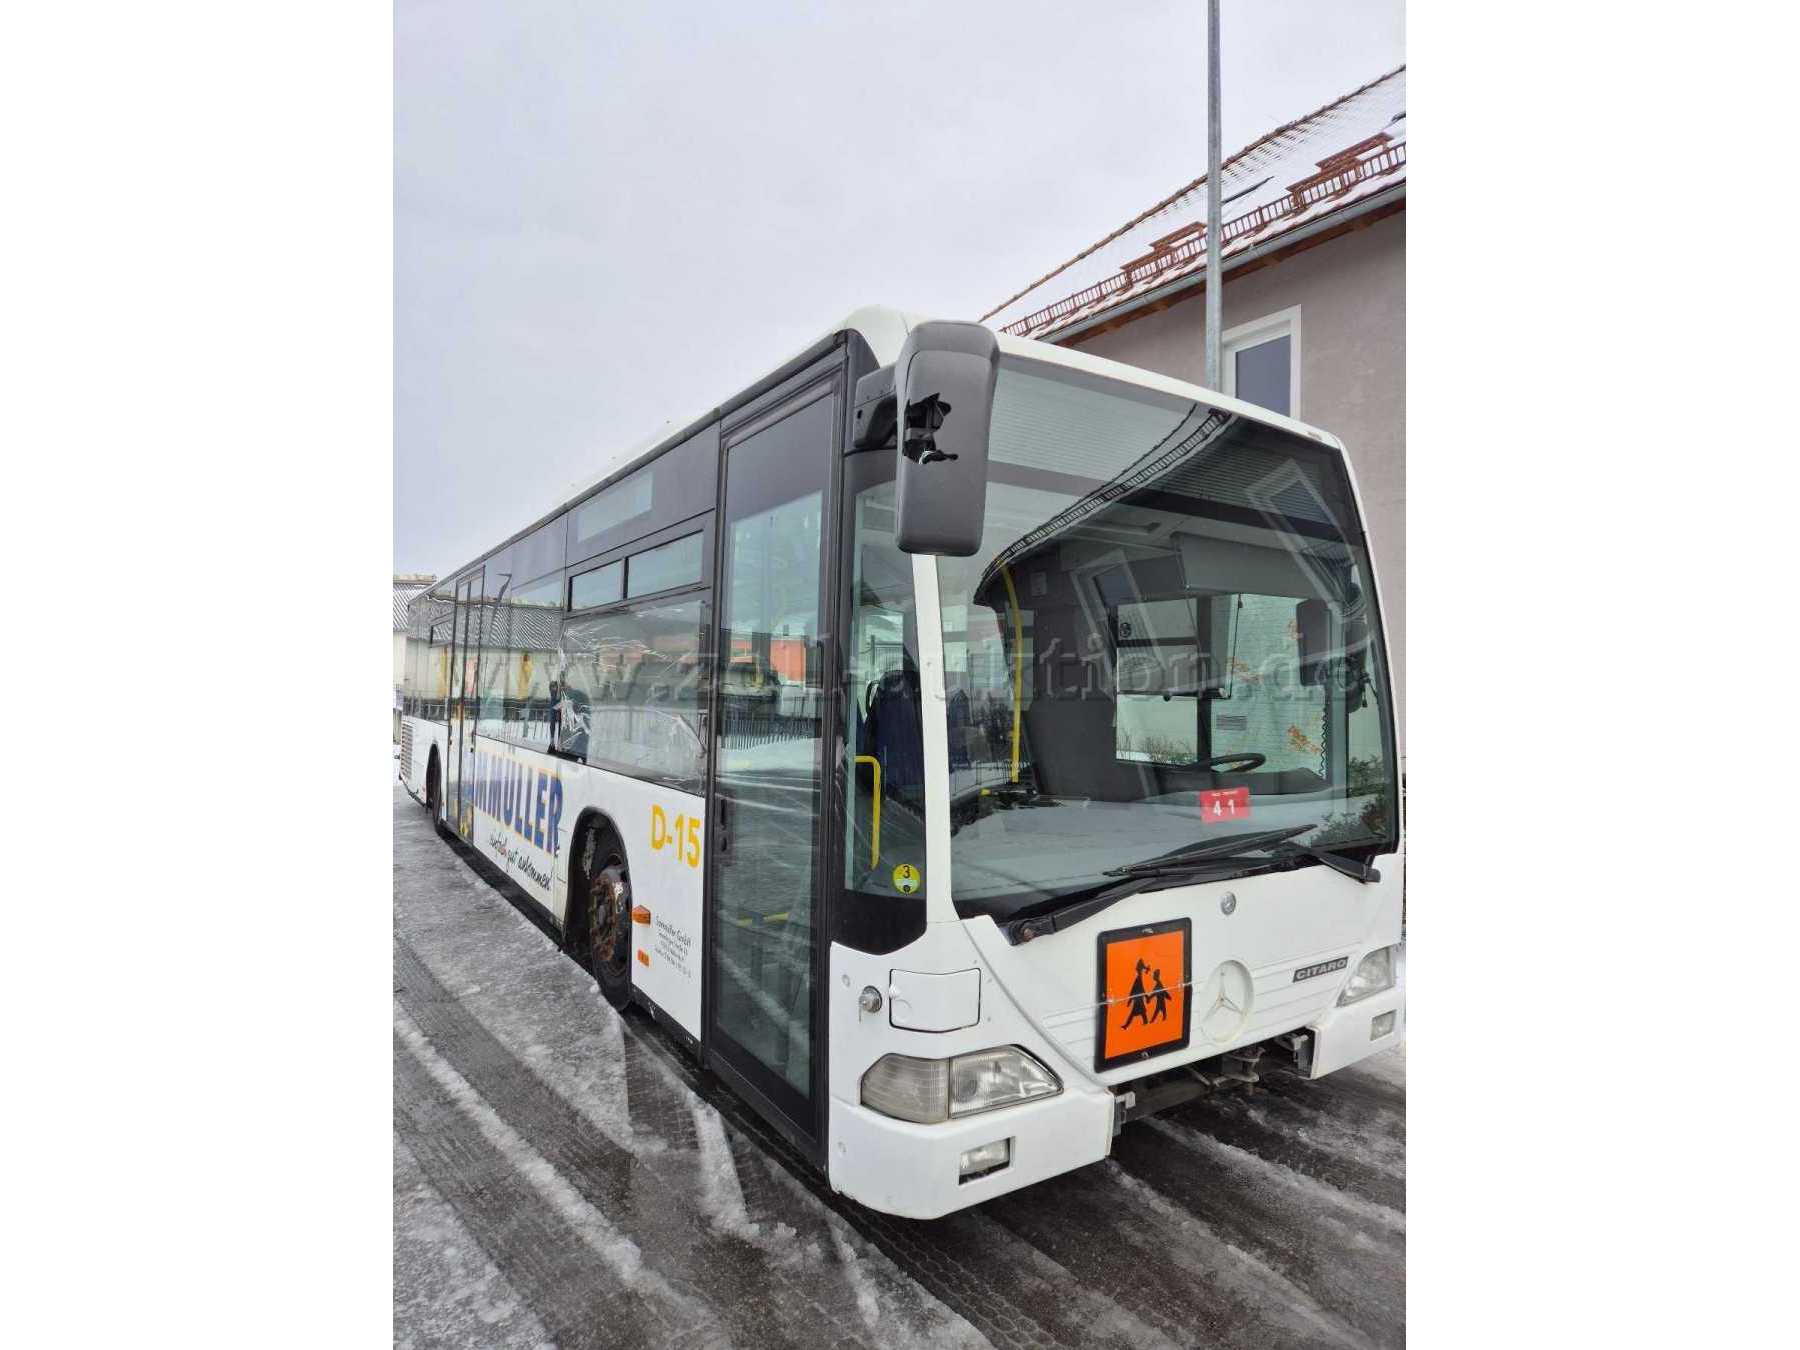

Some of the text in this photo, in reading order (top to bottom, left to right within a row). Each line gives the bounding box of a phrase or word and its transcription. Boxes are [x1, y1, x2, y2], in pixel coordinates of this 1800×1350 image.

[652, 804, 700, 868] D-15
[903, 865, 911, 878] 3
[1296, 959, 1347, 980] CITARO
